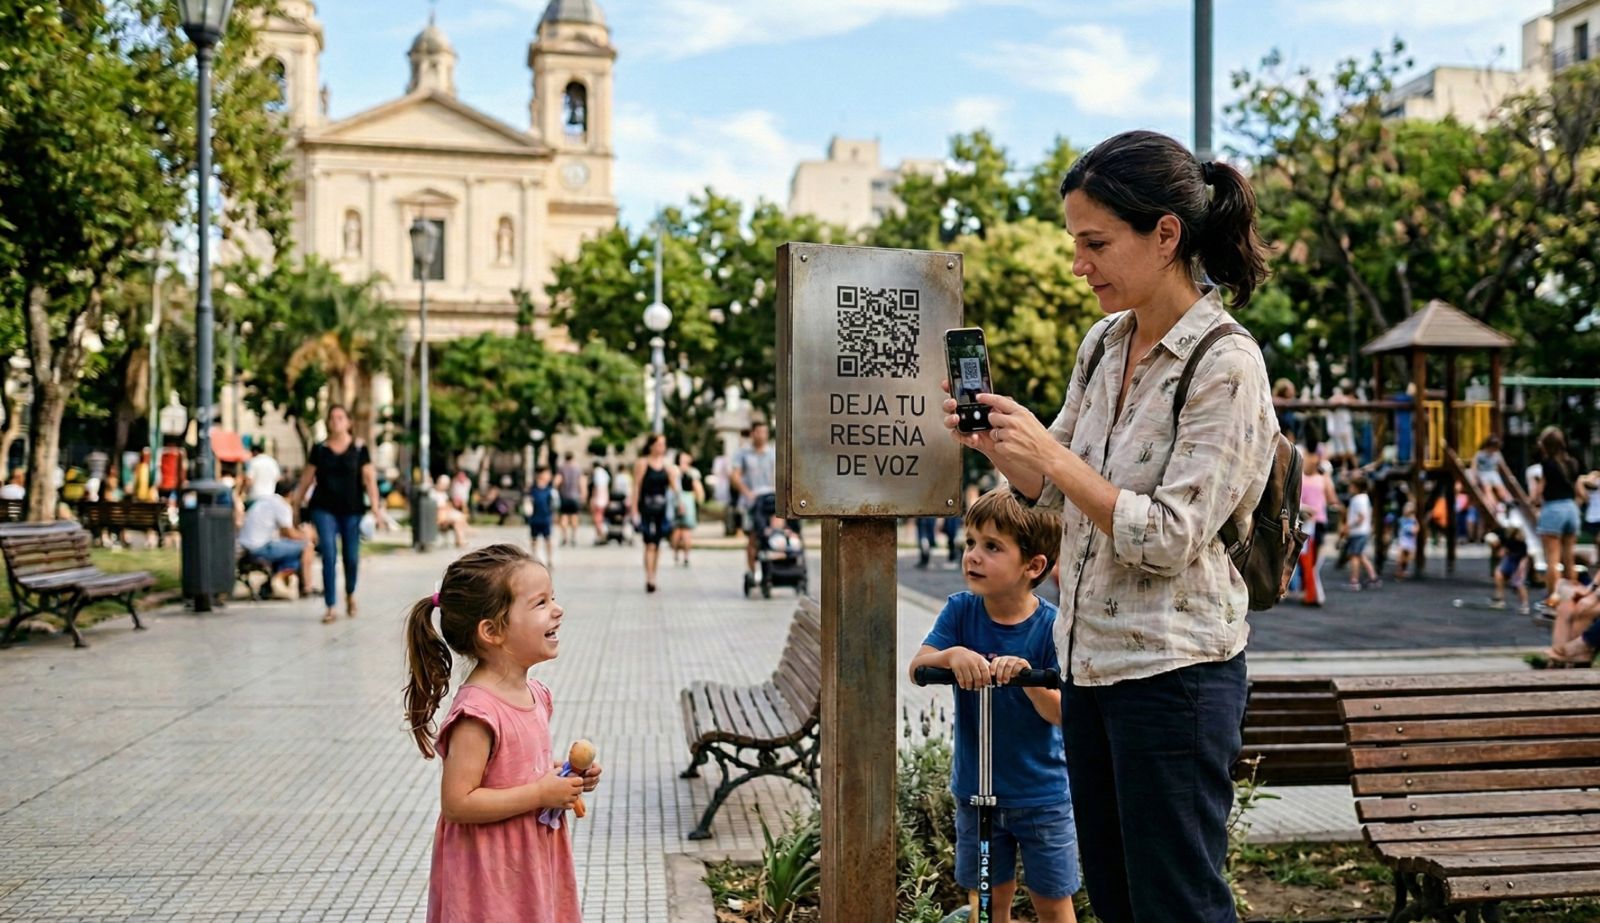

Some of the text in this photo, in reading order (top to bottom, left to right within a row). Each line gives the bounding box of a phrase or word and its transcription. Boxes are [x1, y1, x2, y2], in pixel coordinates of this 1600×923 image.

[830, 393, 925, 416] DEJA TU
[831, 420, 925, 446] RESEÑA
[837, 454, 919, 476] DE VOZ
